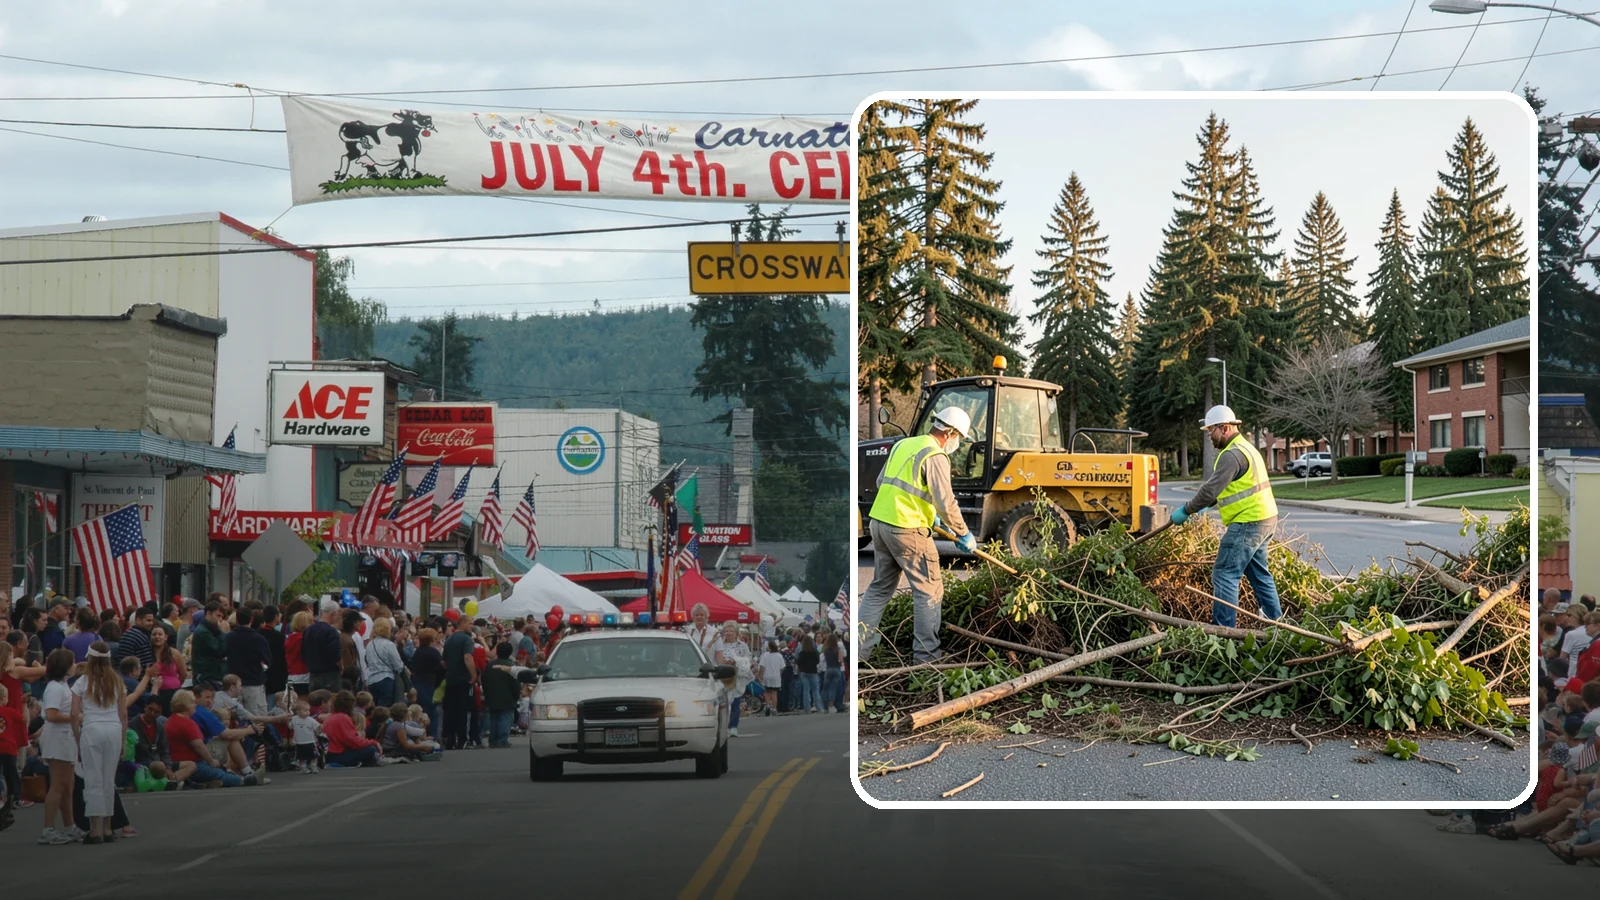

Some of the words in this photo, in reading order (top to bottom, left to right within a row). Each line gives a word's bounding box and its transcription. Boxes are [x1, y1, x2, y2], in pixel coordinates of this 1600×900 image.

[481, 140, 604, 192] JULY
[632, 149, 746, 197] 4th.
[697, 254, 850, 280] CROSSWA
[282, 380, 374, 420] ACE
[405, 409, 453, 422] CEDAR
[283, 421, 371, 437] Hardware
[416, 428, 477, 447] Coca-Cola
[353, 467, 386, 480] Simpl
[95, 485, 124, 495] Vincent
[126, 486, 136, 495] de
[137, 486, 155, 495] Paul
[212, 516, 330, 535] HARDARE
[688, 526, 741, 535] CRNATION
[699, 535, 730, 543] GLASS
